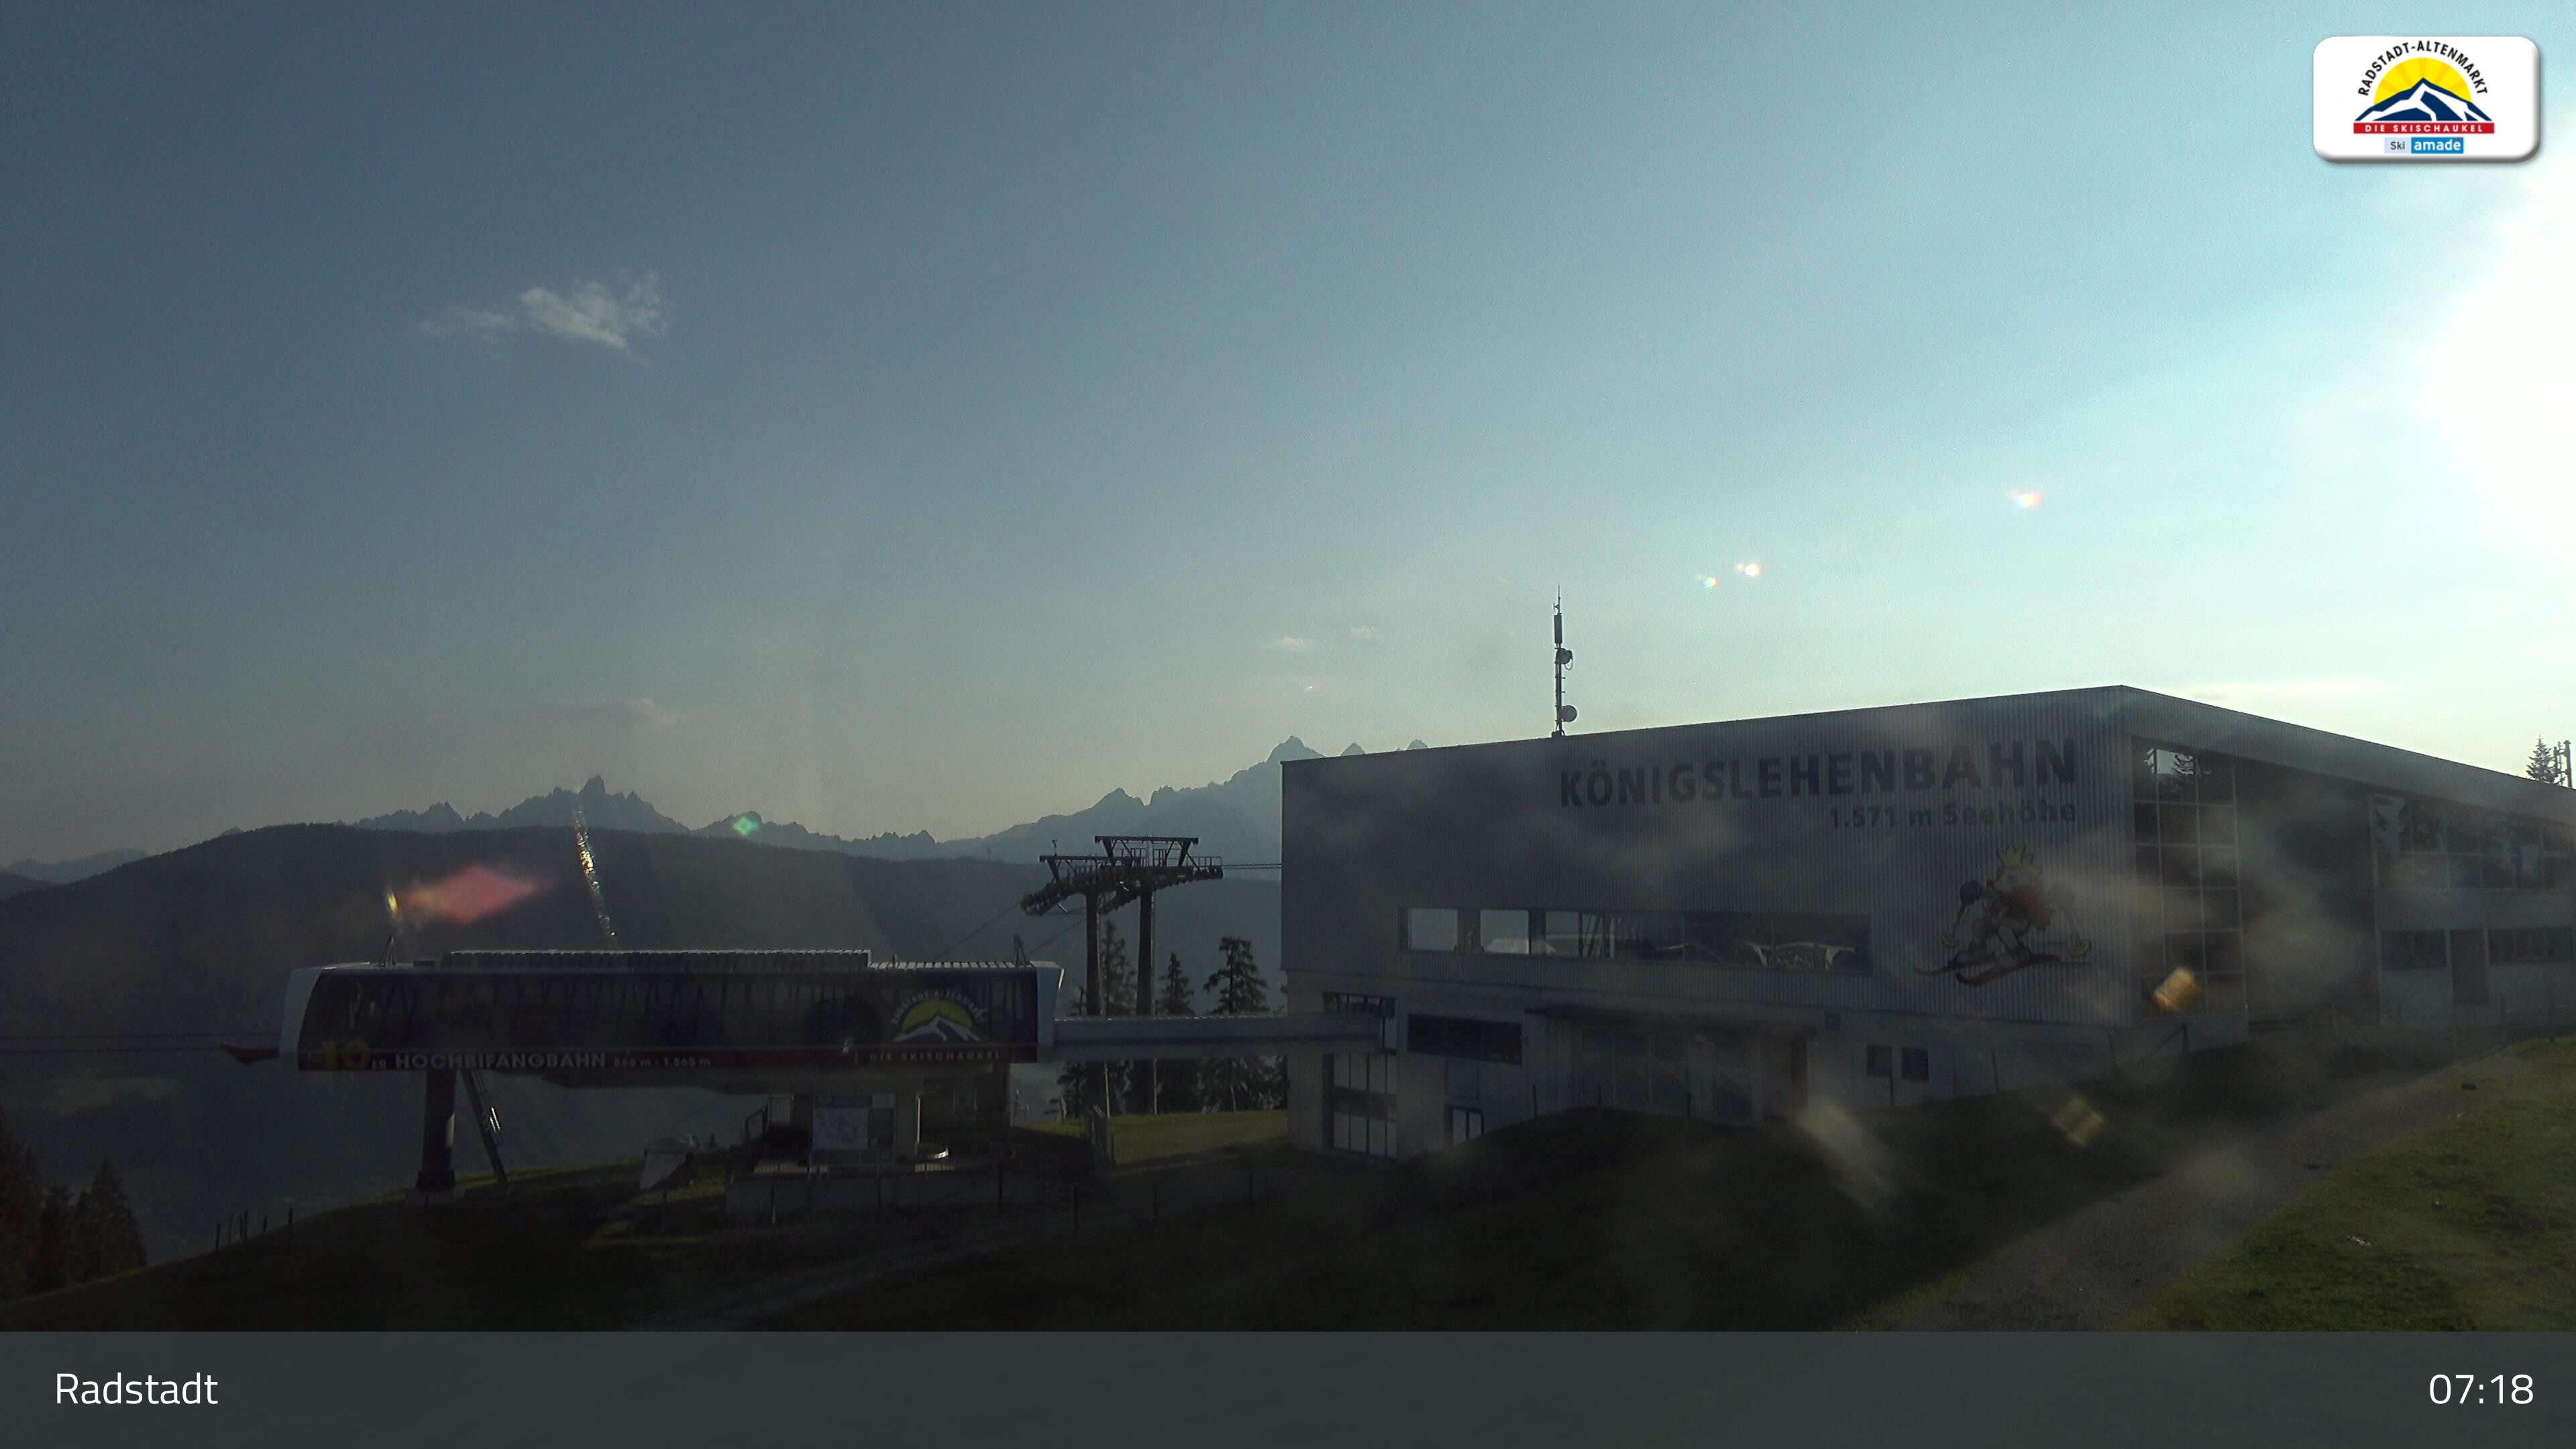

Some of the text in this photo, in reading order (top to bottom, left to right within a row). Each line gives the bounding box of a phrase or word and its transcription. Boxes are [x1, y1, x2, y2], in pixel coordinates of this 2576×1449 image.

[1558, 739, 2077, 808] KÖNIGSLEHENBAHN
[1829, 799, 2078, 829] 1.571 m Seehöhe
